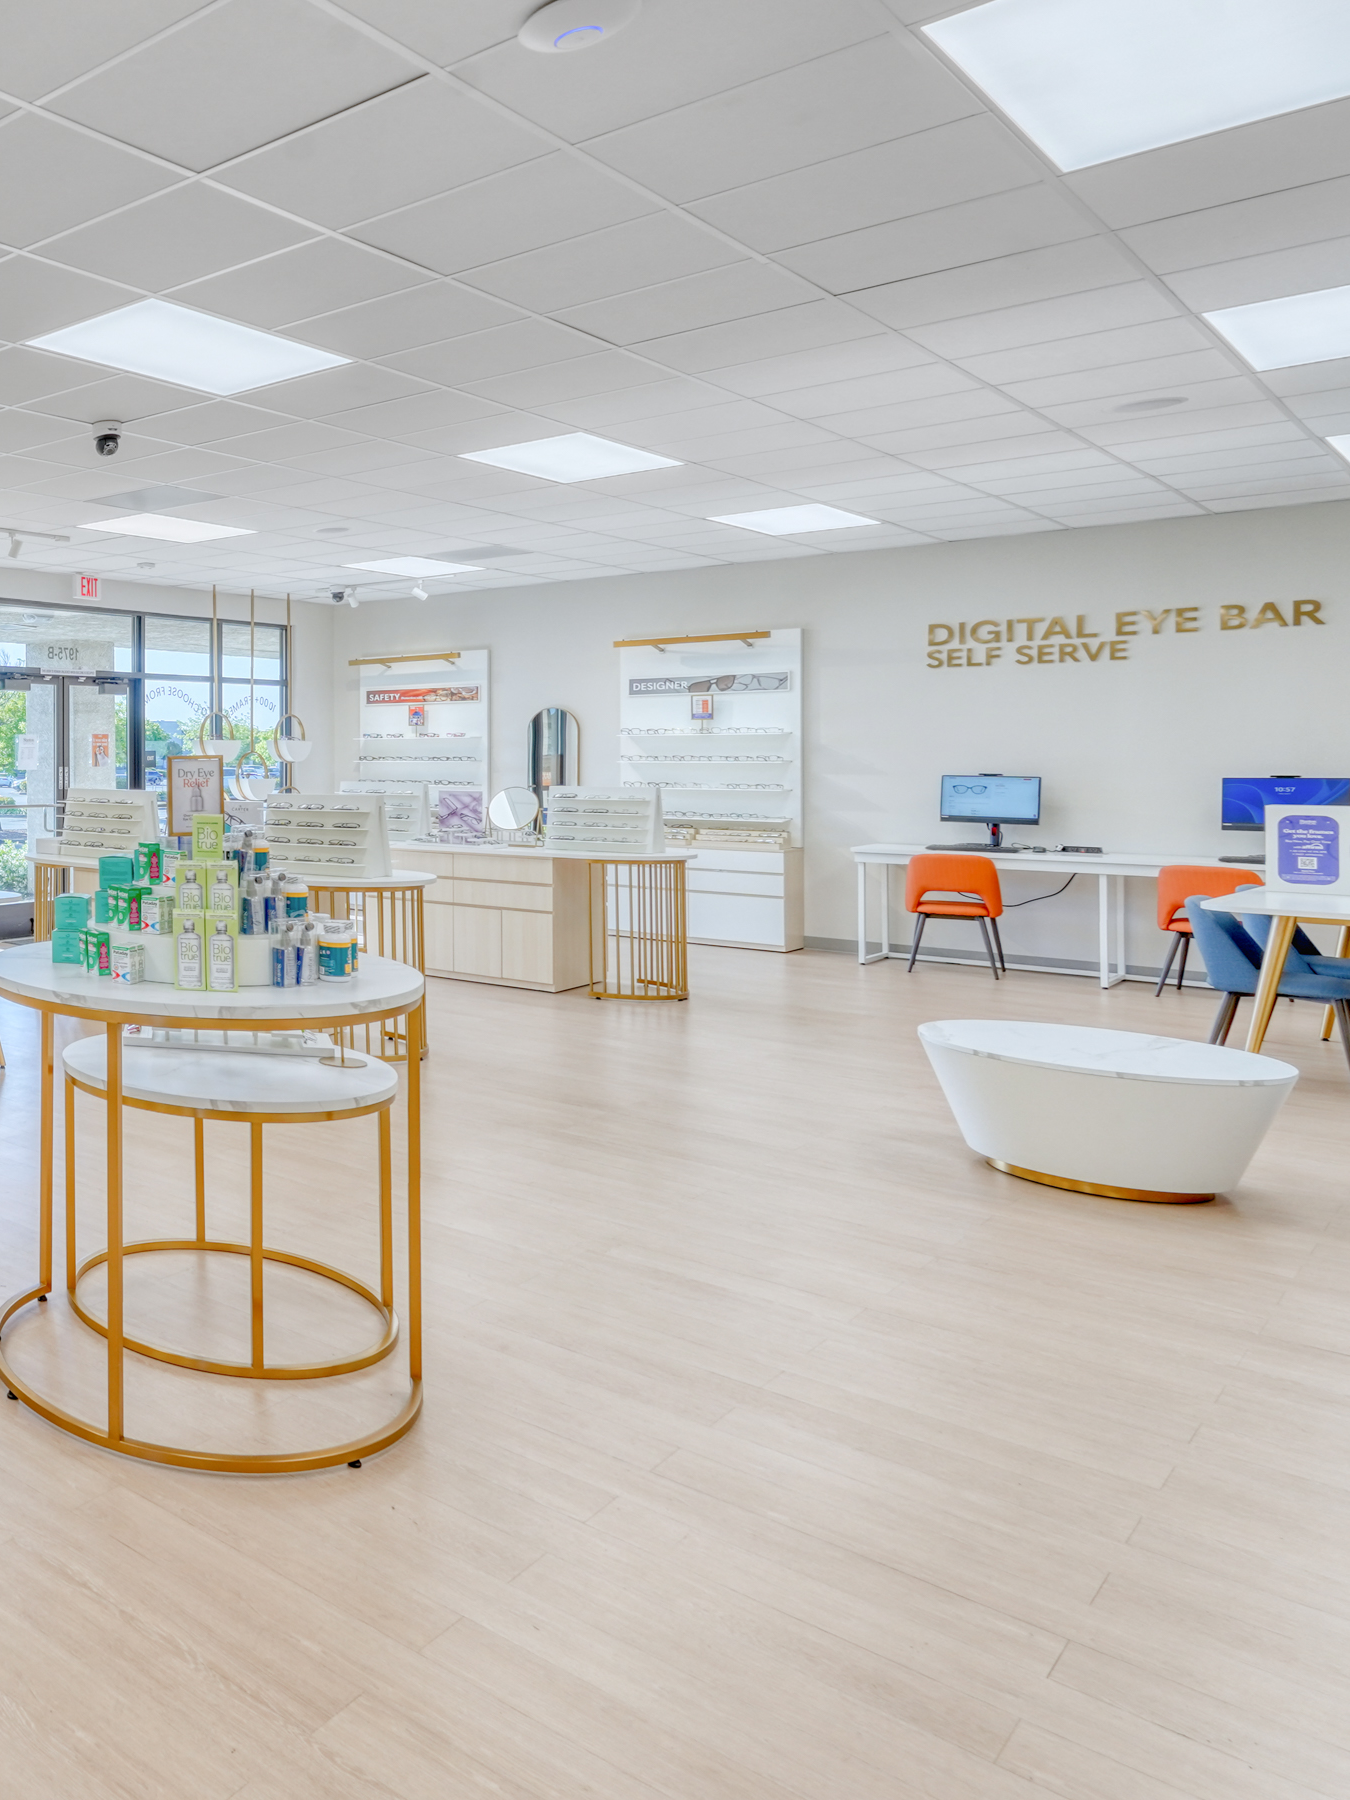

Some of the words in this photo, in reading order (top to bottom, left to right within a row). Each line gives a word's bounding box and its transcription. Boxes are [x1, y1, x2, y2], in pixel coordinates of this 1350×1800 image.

[81, 576, 98, 597] EXIT
[927, 614, 1099, 646] DIGITAL
[1115, 607, 1200, 637] EYE
[1219, 600, 1326, 631] BAR
[925, 646, 1002, 669] SELF
[1014, 640, 1131, 665] SERVE
[632, 681, 688, 691] DESIGNER
[369, 693, 401, 702] SAFETY
[177, 768, 195, 780] Dry
[197, 767, 215, 780] Eye
[183, 777, 210, 788] Relief
[197, 827, 219, 840] Bio
[197, 840, 219, 850] true
[182, 891, 201, 903] Bio
[213, 892, 232, 904] Bio
[182, 902, 201, 910] true
[213, 902, 232, 911] true
[180, 941, 199, 953] Bio
[212, 943, 232, 955] Bio
[180, 953, 199, 961] true
[213, 954, 231, 963] true
